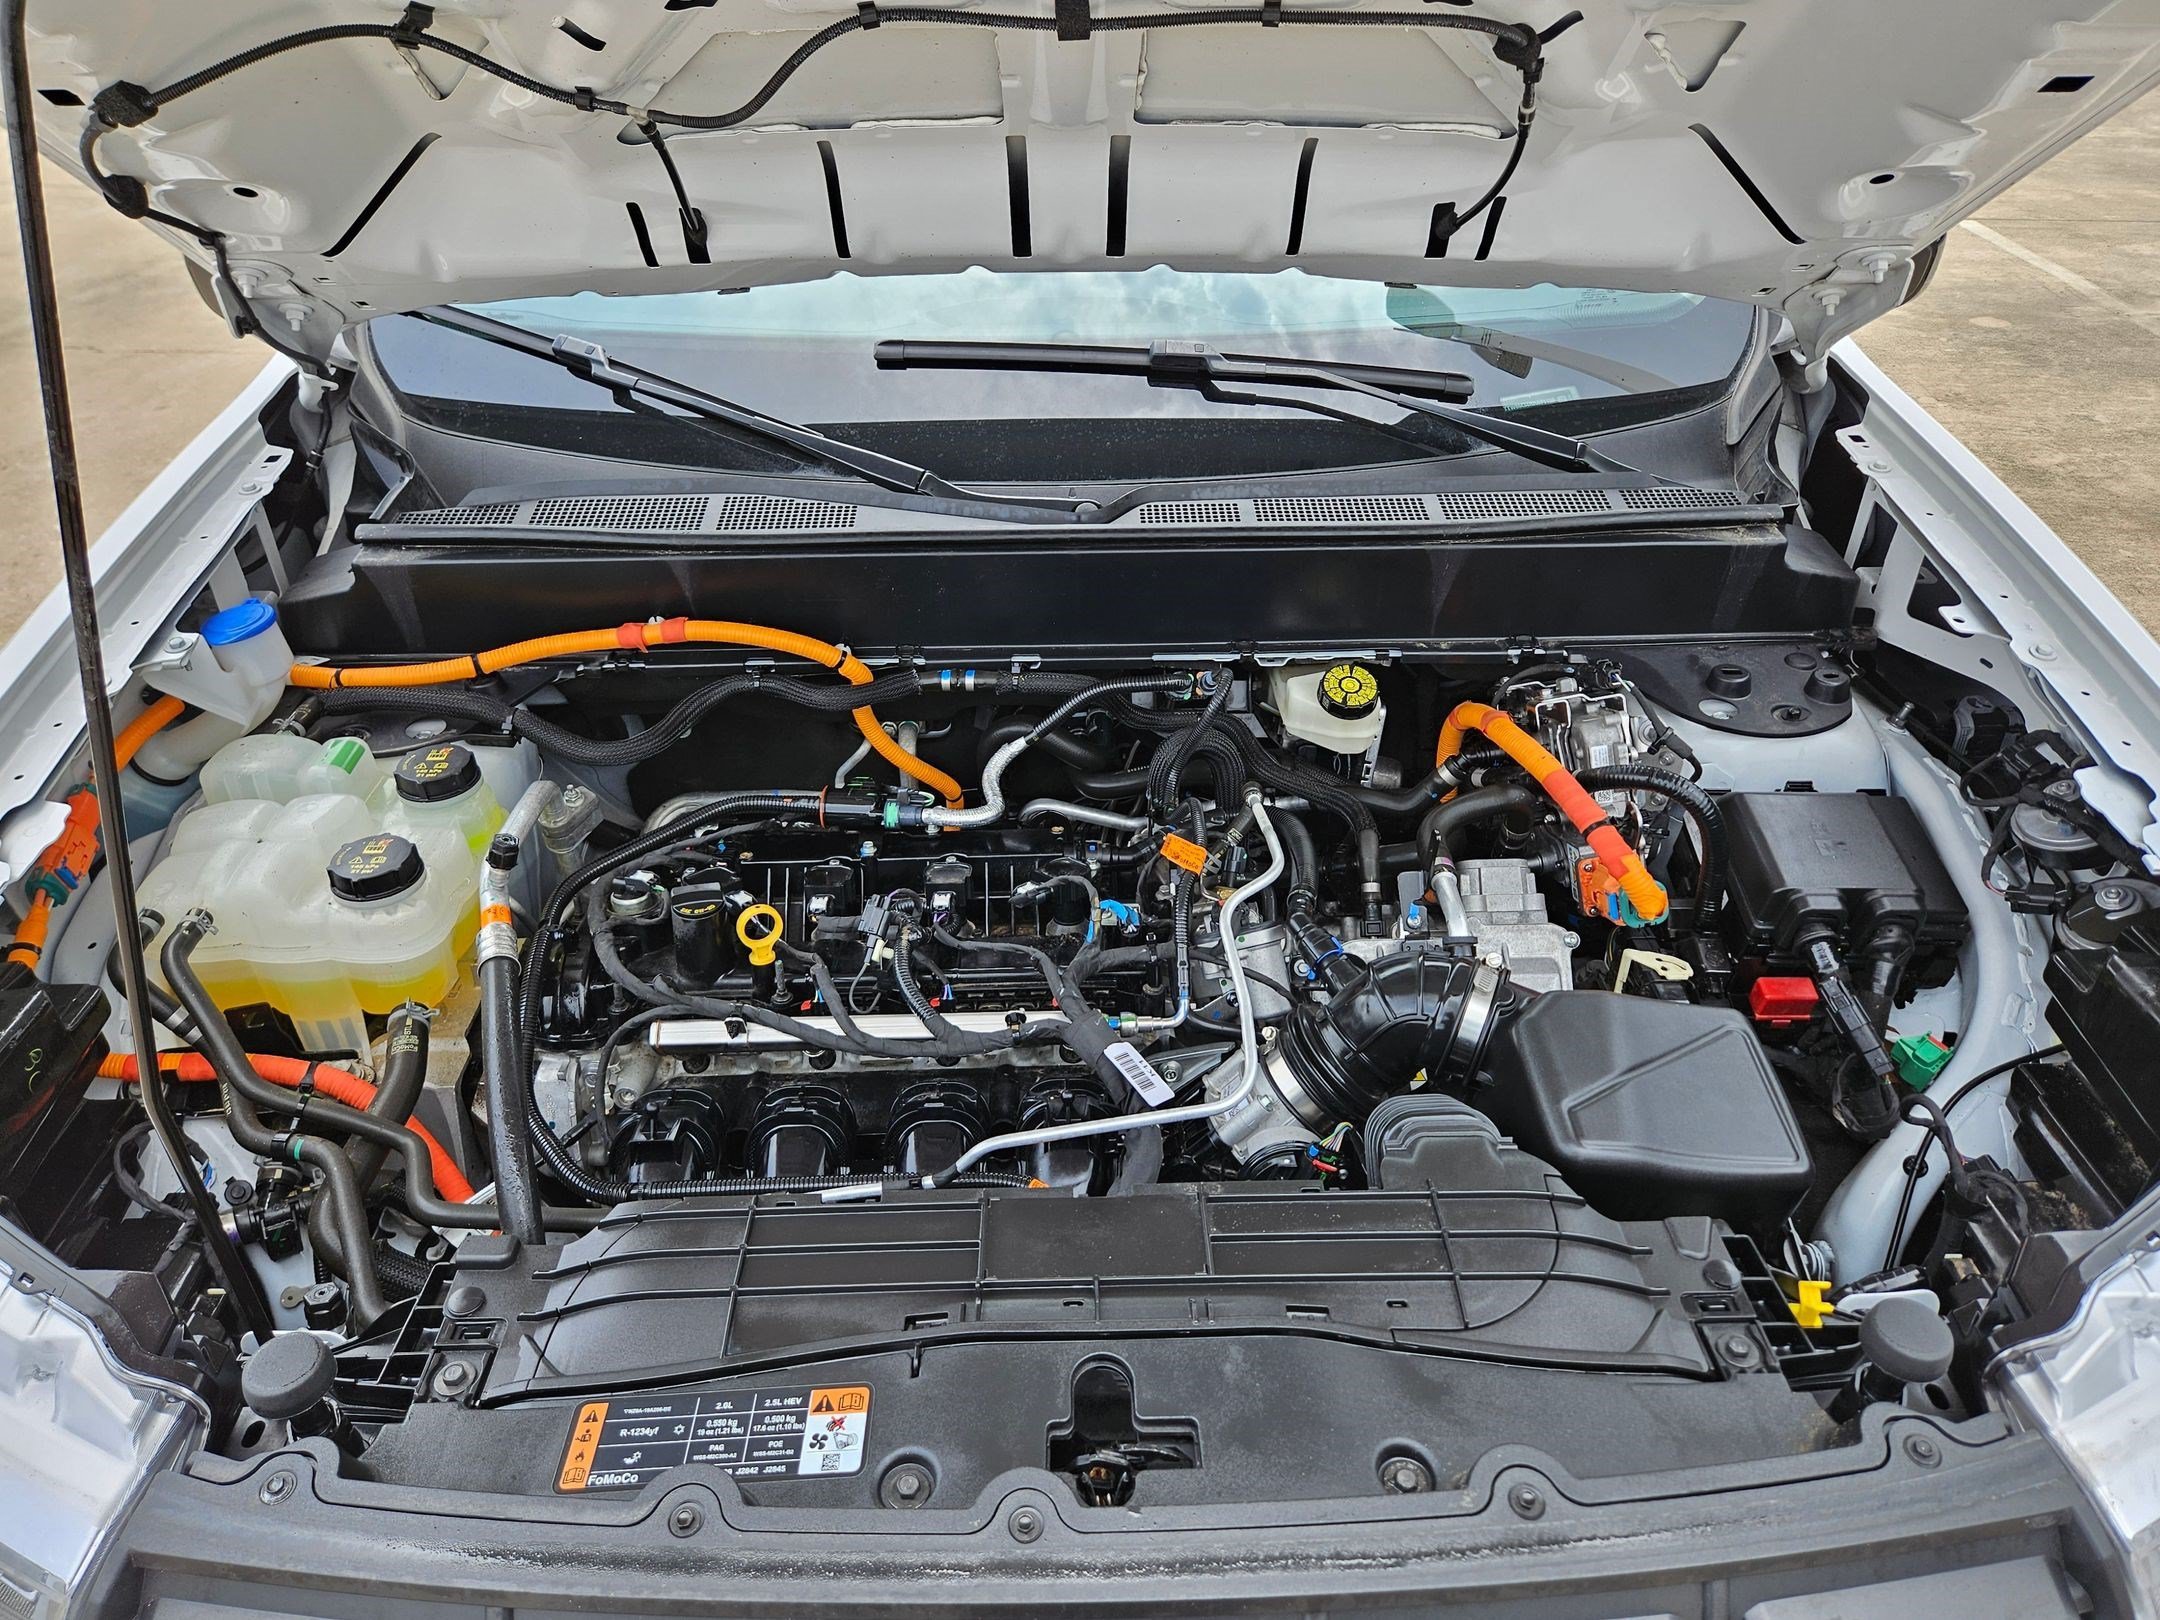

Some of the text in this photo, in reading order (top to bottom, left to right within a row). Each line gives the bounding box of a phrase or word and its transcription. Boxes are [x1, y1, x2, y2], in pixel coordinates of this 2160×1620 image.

[764, 1397, 802, 1406] 2.5L HEV
[728, 1419, 738, 1427] kg
[764, 1415, 796, 1423] 0.500 kg
[619, 1427, 659, 1437] R-1234yf
[715, 1427, 730, 1436] (1.21
[709, 1444, 725, 1452] PAG
[768, 1440, 783, 1448] POE
[587, 1473, 639, 1485] FoMoCo
